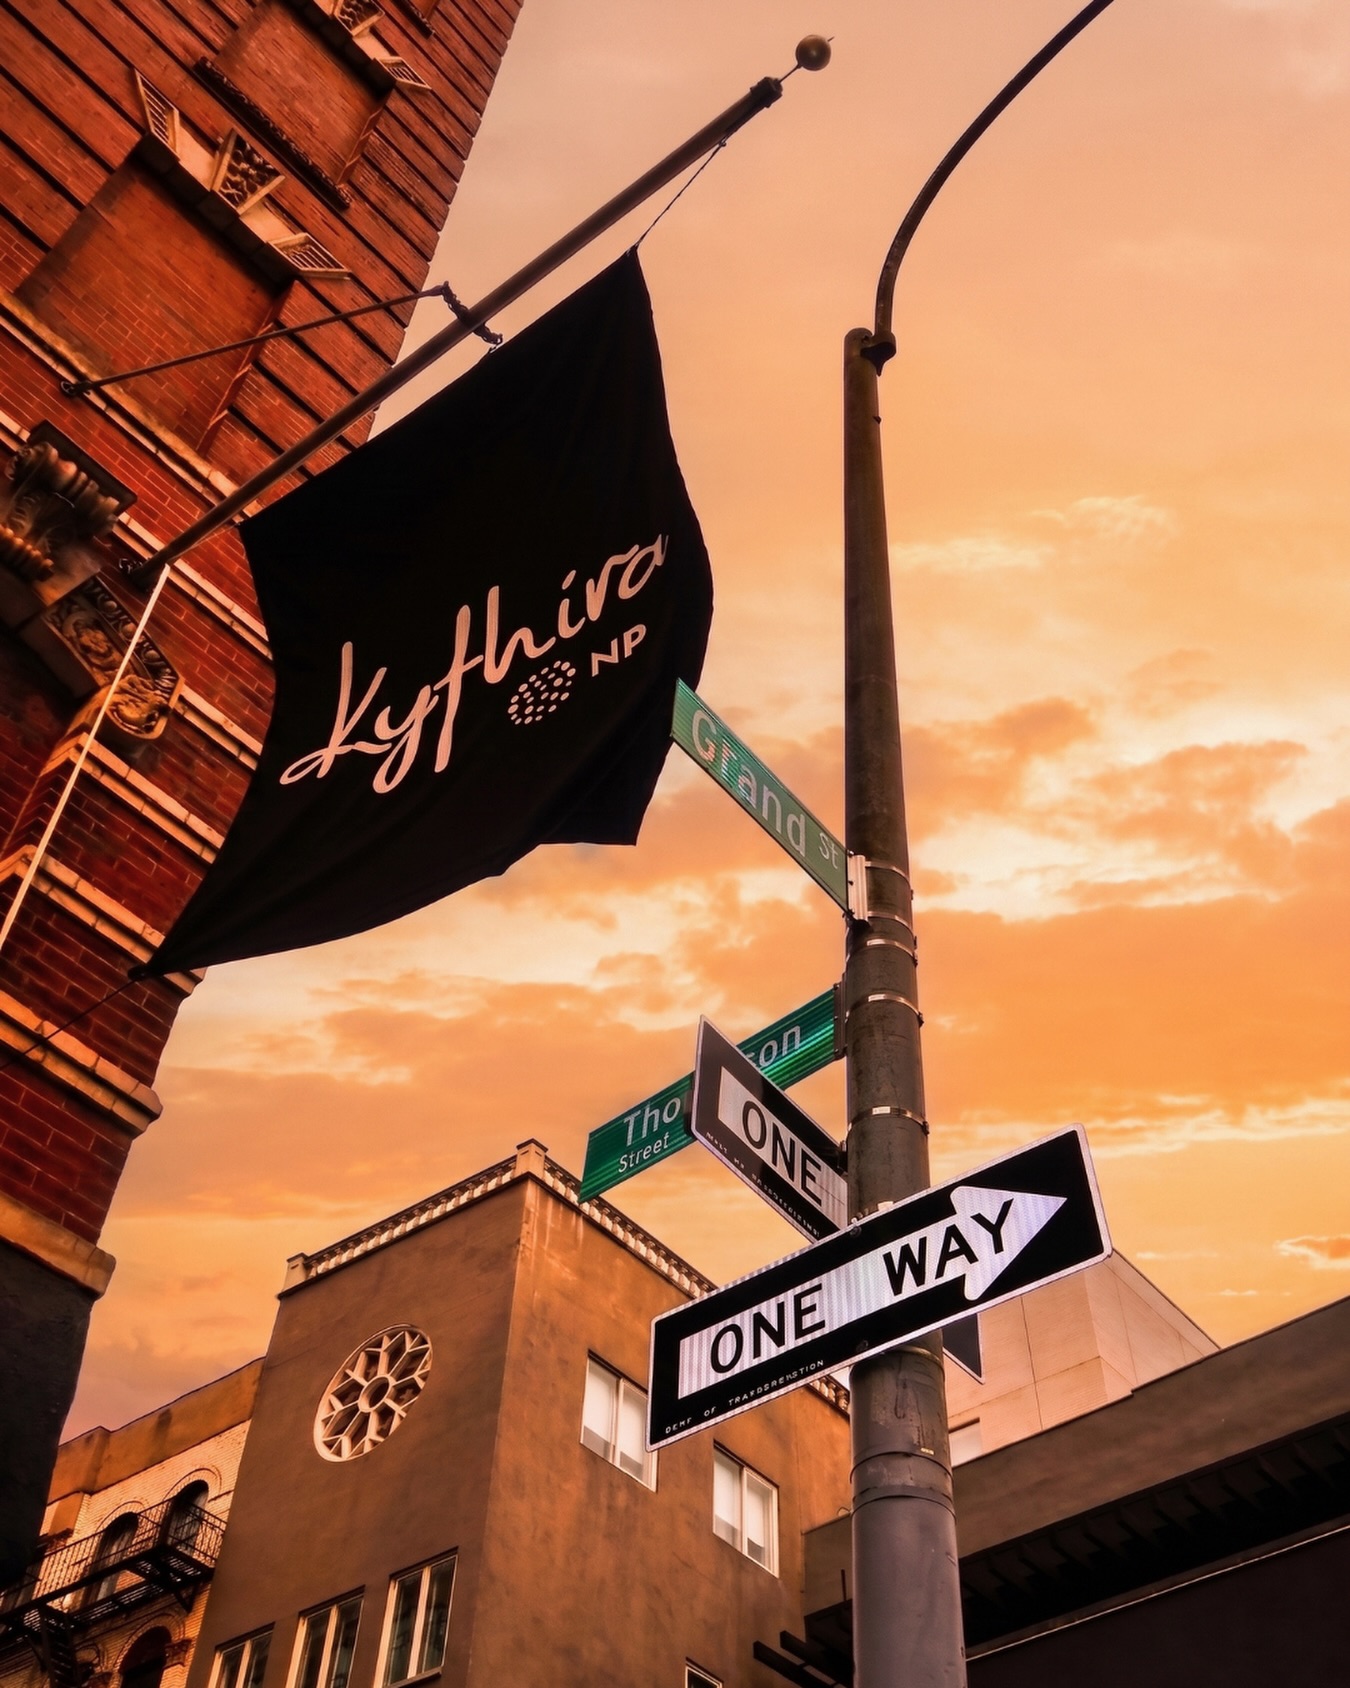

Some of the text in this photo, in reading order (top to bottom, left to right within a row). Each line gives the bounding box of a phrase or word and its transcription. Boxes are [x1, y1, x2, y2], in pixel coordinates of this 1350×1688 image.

[280, 534, 669, 793] Kythira
[592, 624, 646, 677] NP
[692, 709, 839, 870] Grand St
[624, 1025, 800, 1147] Thoon
[618, 1132, 670, 1173] Street
[742, 1100, 821, 1207] ONE
[710, 1198, 1015, 1374] ONE WAY
